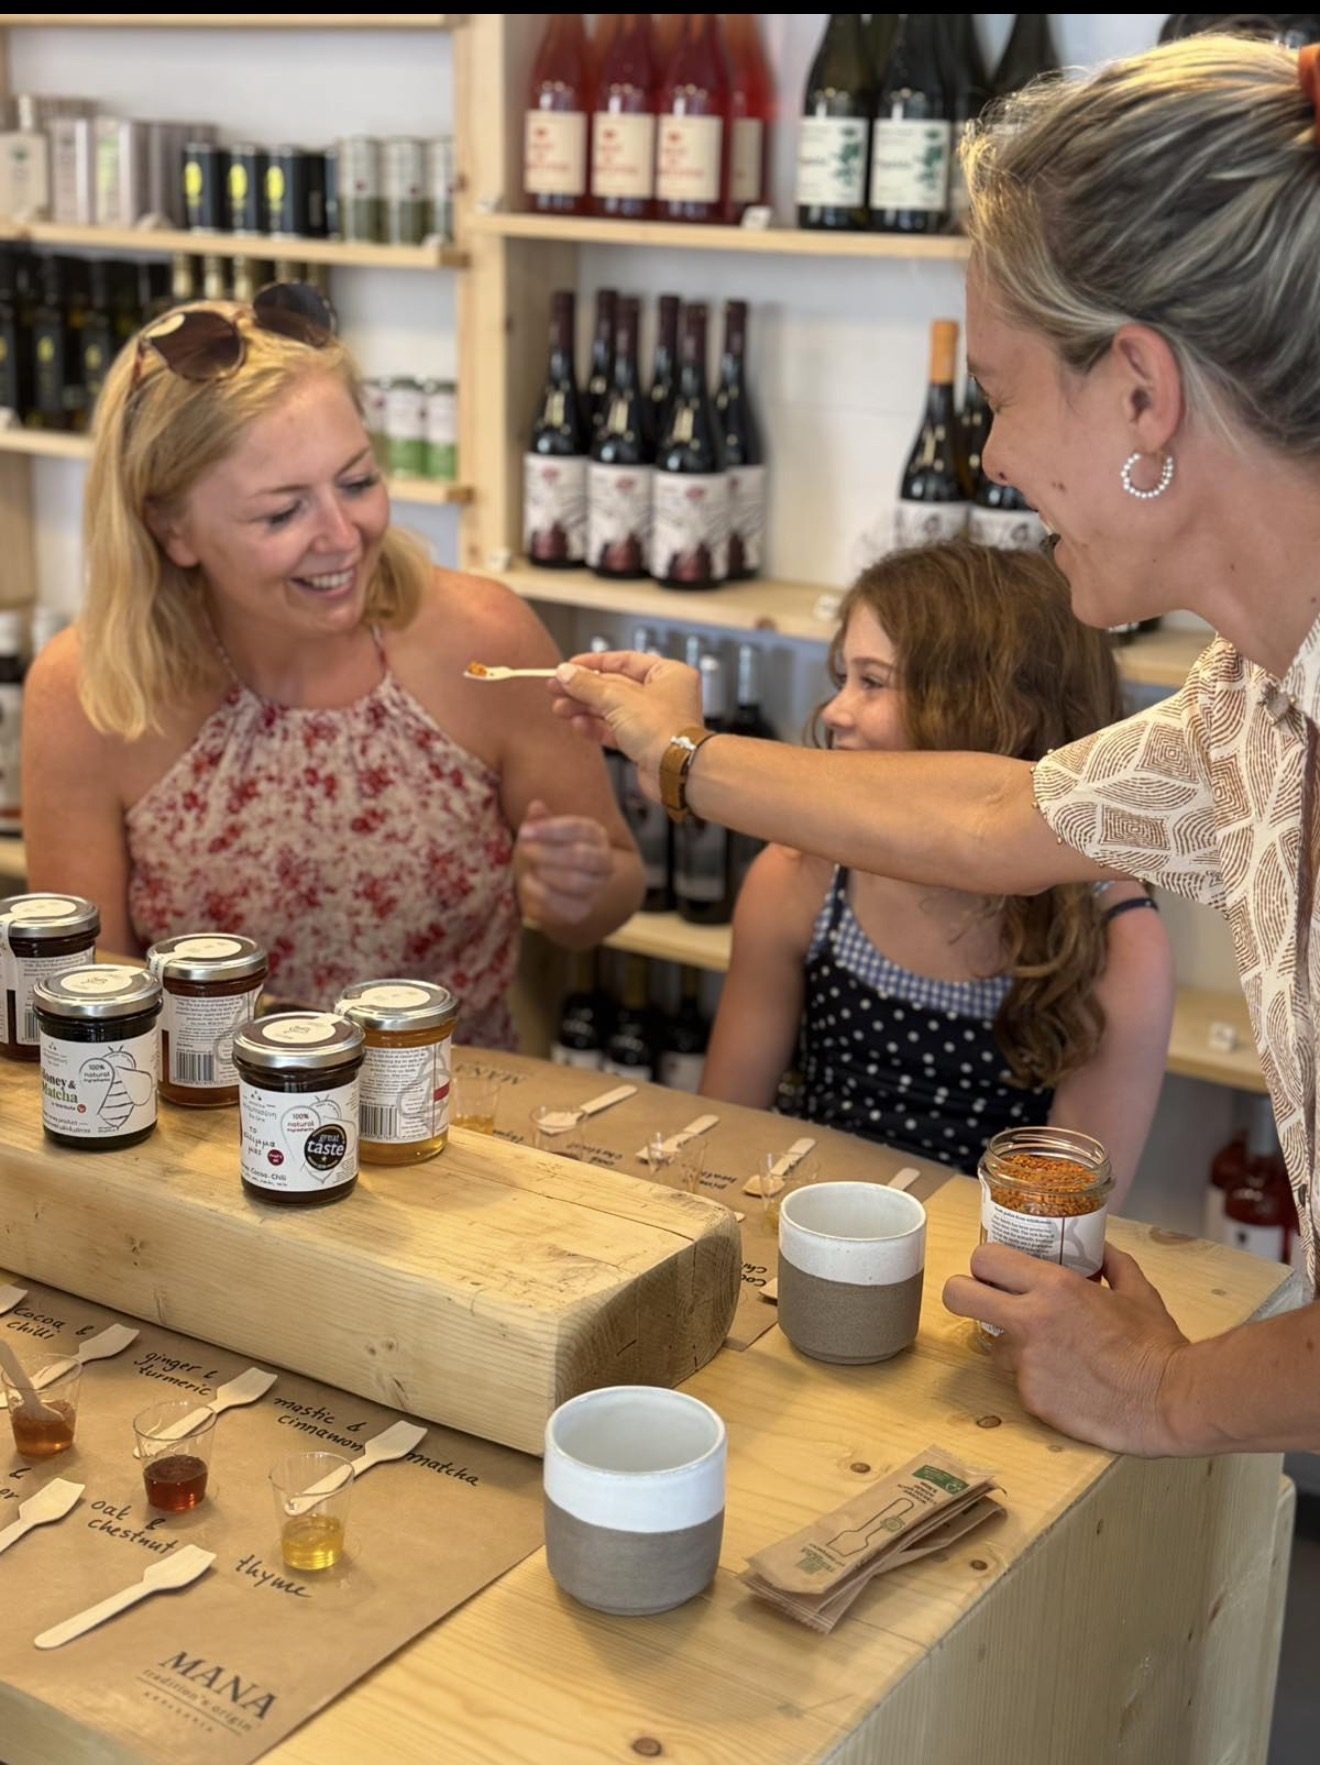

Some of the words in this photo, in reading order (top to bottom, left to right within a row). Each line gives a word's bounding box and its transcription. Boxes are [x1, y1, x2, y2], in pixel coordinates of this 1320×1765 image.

[67, 1080, 76, 1090] &
[306, 1140, 345, 1157] taste
[318, 1134, 340, 1143] great
[133, 1350, 201, 1373] ginger
[137, 1365, 213, 1397] turmeric
[273, 1396, 336, 1425] mastic
[277, 1413, 364, 1452] cinnamon
[404, 1451, 480, 1487] matcha
[87, 1518, 179, 1555] chestnut
[234, 1553, 313, 1599] thyme
[142, 1668, 209, 1707] tradition's
[211, 1704, 254, 1732] origin
[158, 1650, 278, 1720] MANA
